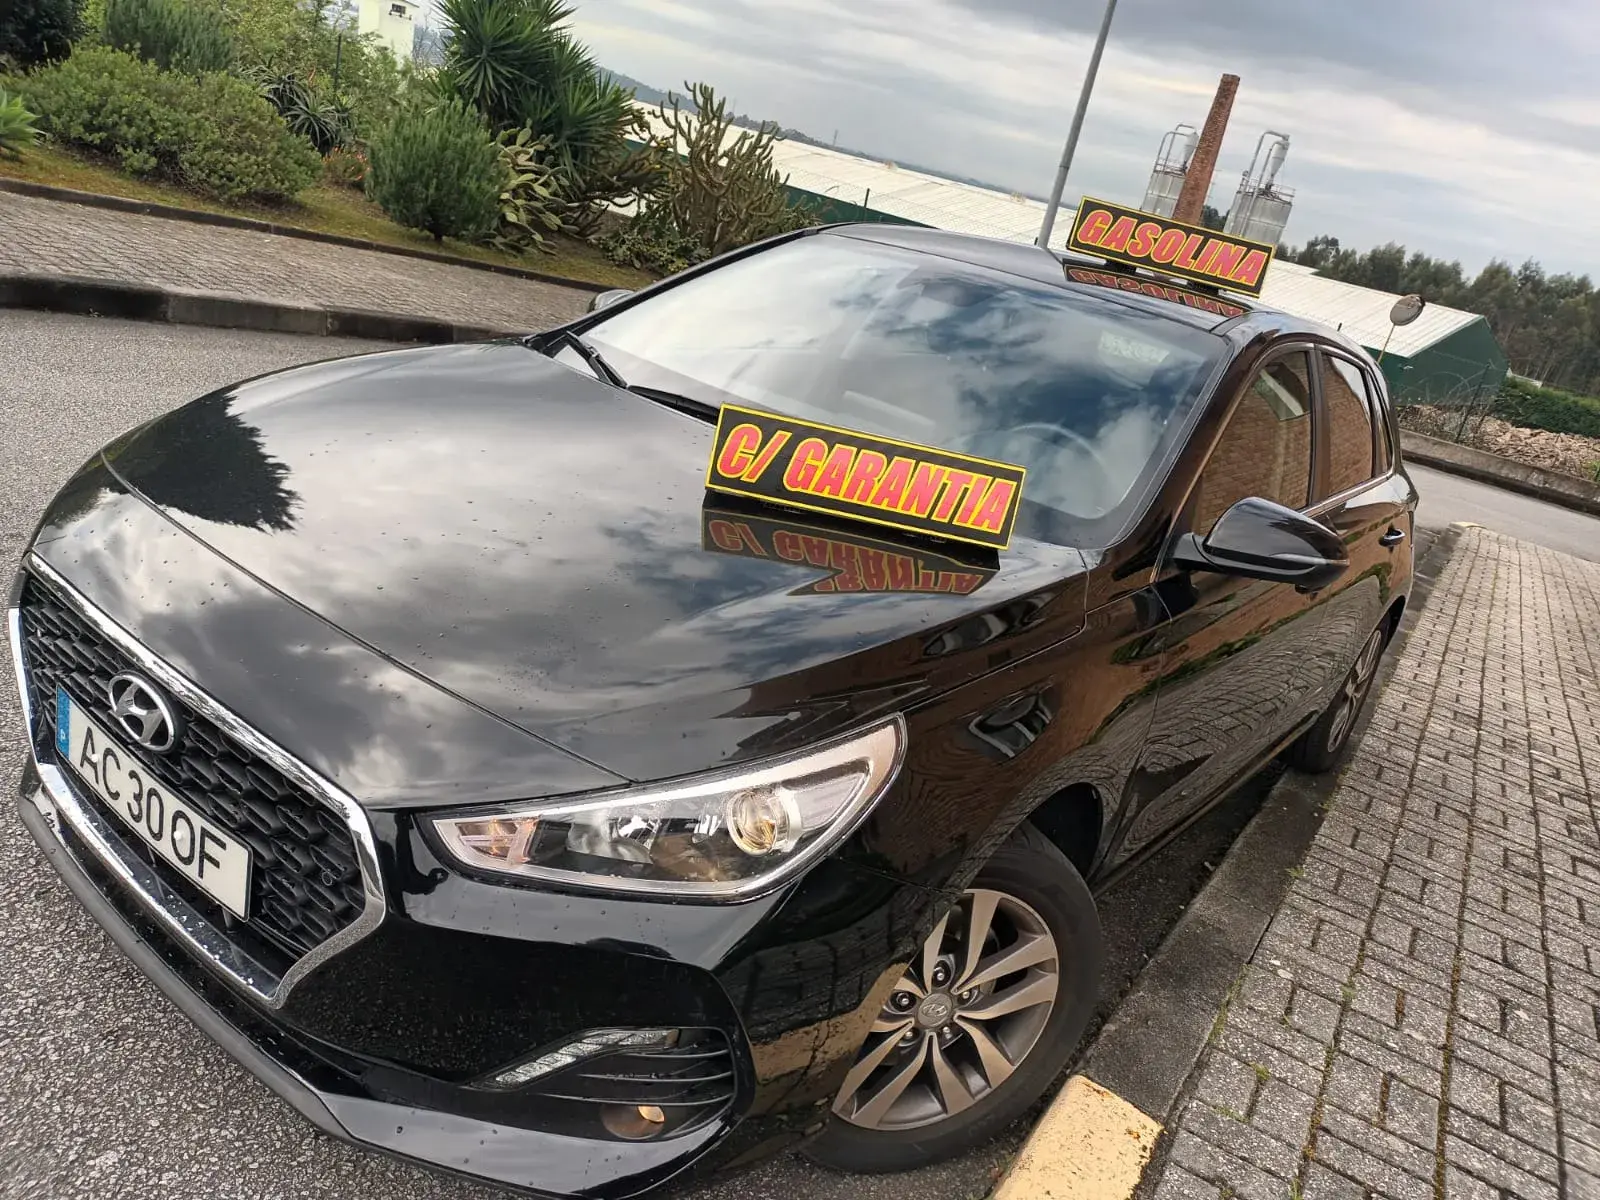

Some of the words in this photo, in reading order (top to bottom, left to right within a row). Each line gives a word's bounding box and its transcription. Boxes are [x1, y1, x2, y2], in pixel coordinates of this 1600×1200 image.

[1077, 210, 1268, 286] GASOLINA
[716, 423, 792, 483] C/
[782, 437, 1018, 534] GARANTIA
